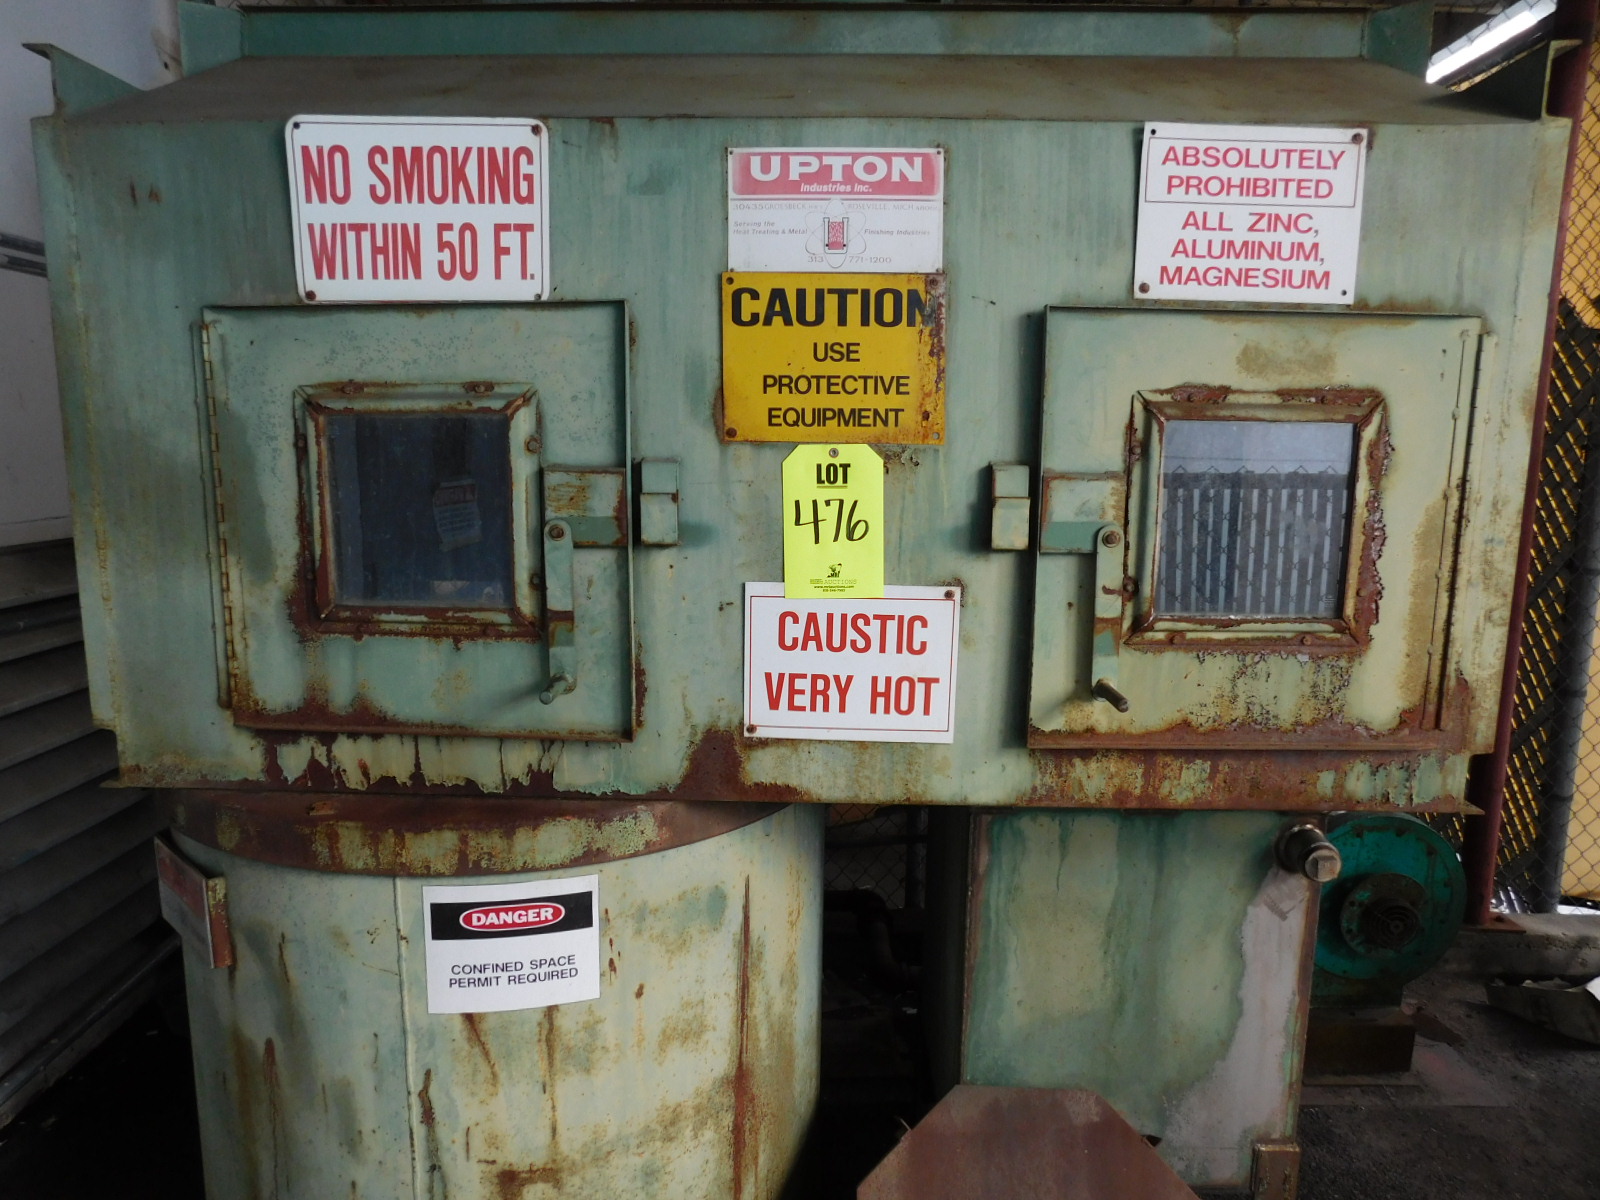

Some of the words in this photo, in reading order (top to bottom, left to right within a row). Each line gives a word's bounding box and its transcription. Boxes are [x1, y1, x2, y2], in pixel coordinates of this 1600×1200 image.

[750, 155, 923, 183] UPTON
[1161, 145, 1346, 171] ABSOLUTELY
[301, 144, 351, 205] NO
[367, 145, 535, 205] SMOKING
[800, 183, 852, 193] Industries
[854, 183, 873, 193] Inc.
[1166, 175, 1334, 199] PROHIBITED
[864, 228, 894, 236] Finishing
[1181, 210, 1234, 232] ALL
[1247, 212, 1320, 238] ZINC,
[307, 222, 422, 281] WITHIN
[437, 221, 479, 281] 50
[493, 223, 535, 281] FT.
[807, 255, 824, 264] 313
[1170, 238, 1325, 266] ALUMINUM,
[1159, 265, 1331, 290] MAGNESIUM
[731, 287, 936, 328] CAUTION
[813, 342, 860, 362] USE
[763, 374, 910, 395] PROTECTIVE
[767, 407, 904, 428] EQUIPMENT
[816, 463, 851, 485] LOT
[794, 498, 870, 544] 476
[777, 611, 929, 656] CAUSTIC
[764, 671, 854, 713] VERY
[869, 675, 940, 717] HOT
[471, 907, 554, 926] DANGER
[450, 960, 524, 975] CONFINED
[529, 954, 576, 970] SPACE
[449, 975, 502, 988] PERMIT
[507, 967, 579, 985] REQUIRED
